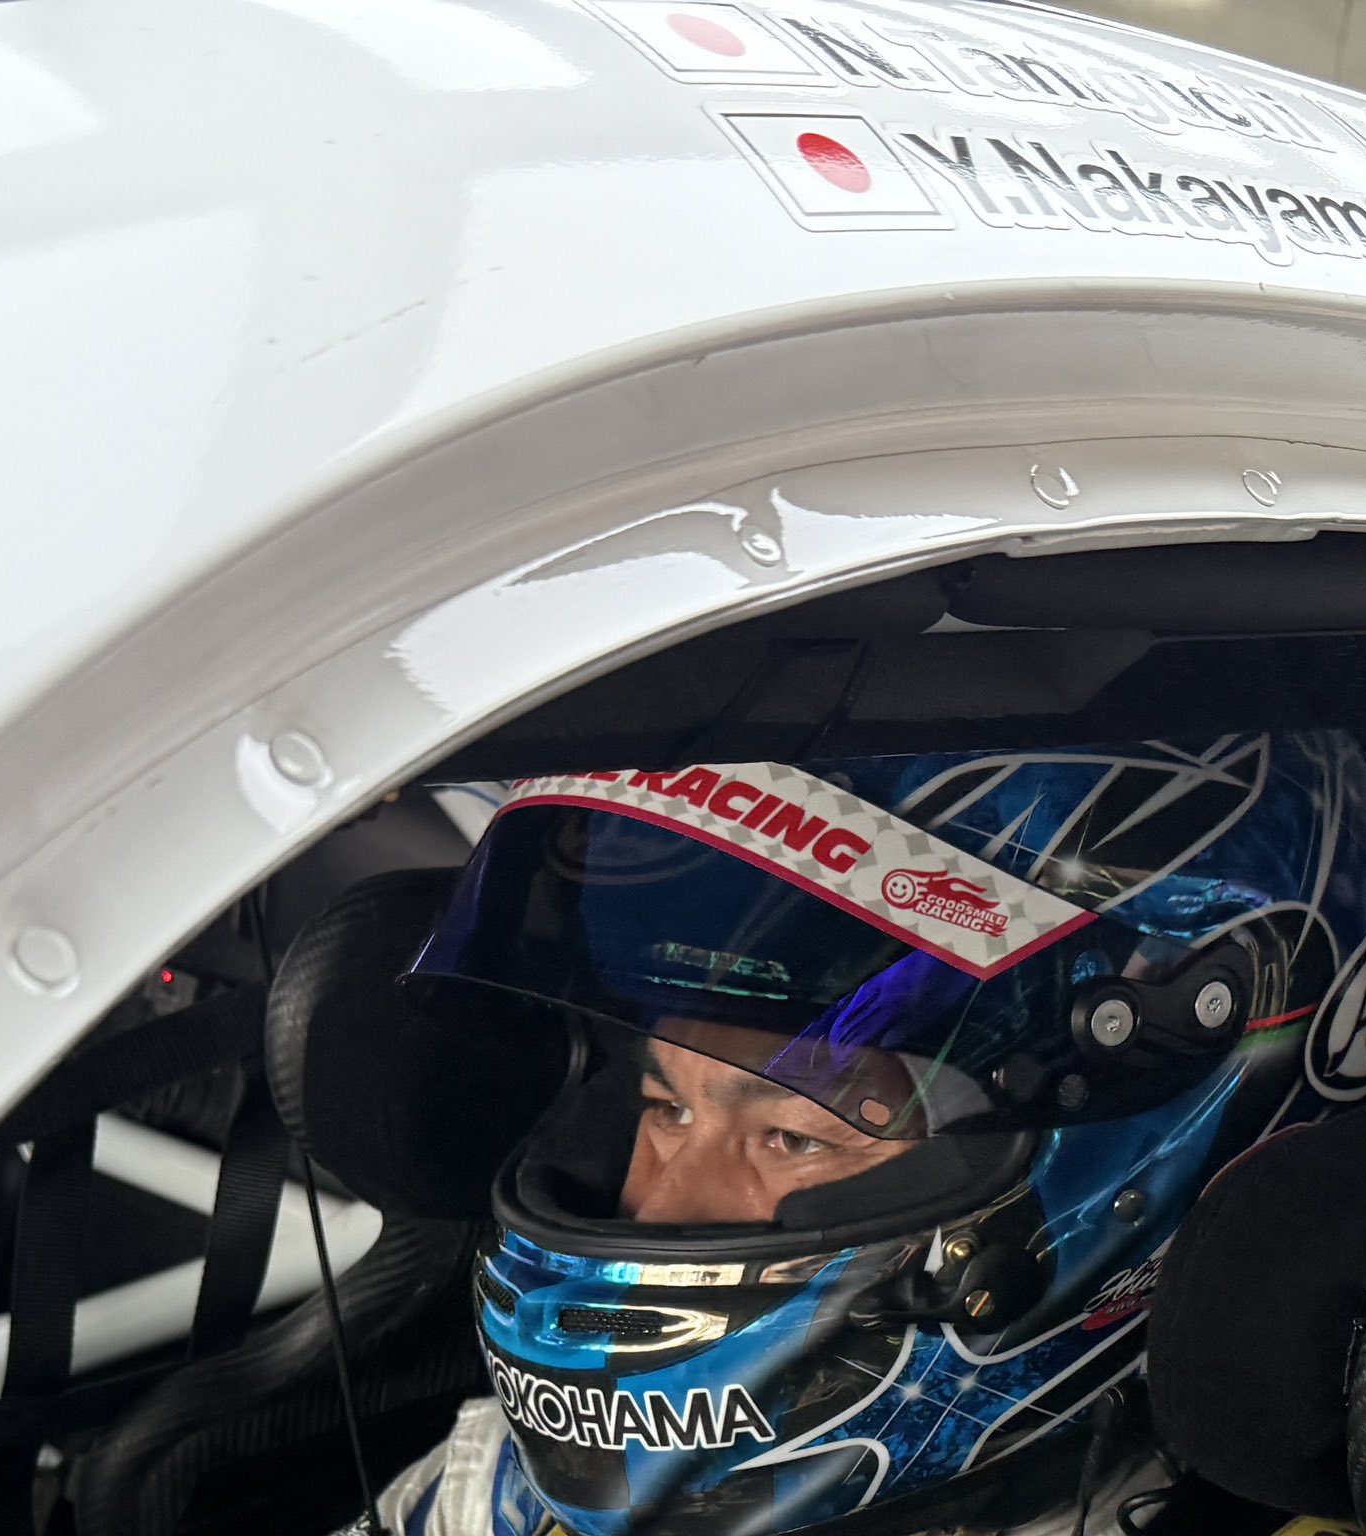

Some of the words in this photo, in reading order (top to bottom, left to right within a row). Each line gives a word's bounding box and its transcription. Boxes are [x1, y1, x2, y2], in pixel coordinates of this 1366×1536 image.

[915, 901, 985, 932] RACING
[925, 893, 1008, 927] GOODSMILE
[488, 1350, 777, 1451] OKOHAMA
